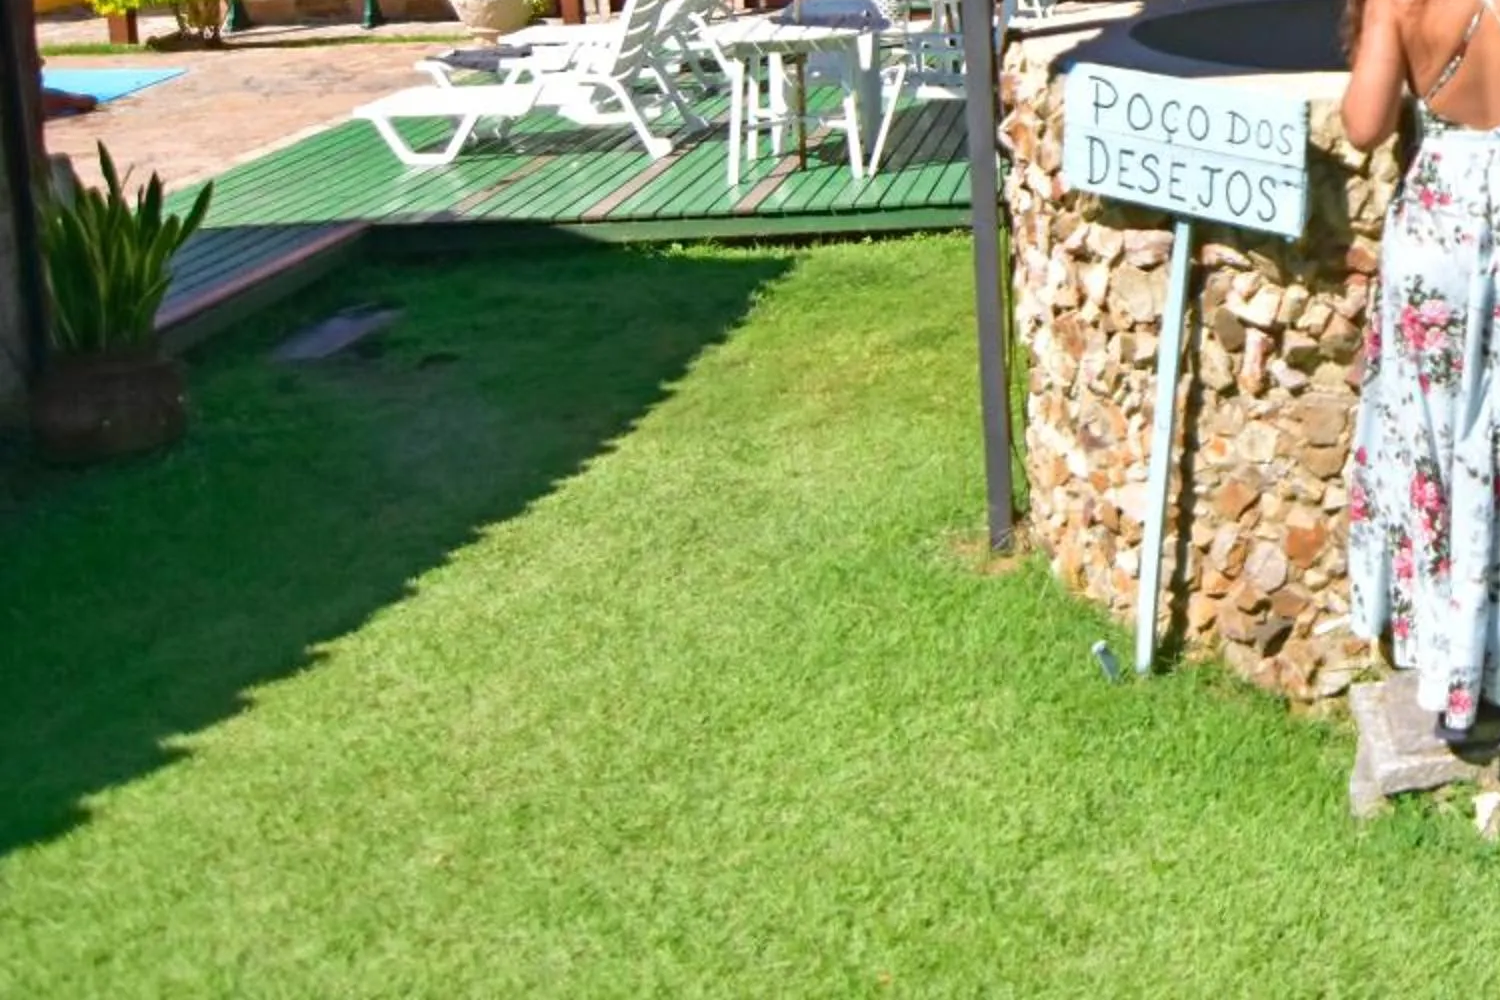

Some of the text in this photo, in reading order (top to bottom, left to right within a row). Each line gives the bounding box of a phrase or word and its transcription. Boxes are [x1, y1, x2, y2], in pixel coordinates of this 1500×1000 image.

[1088, 75, 1296, 156] POÇO DOS
[1084, 135, 1277, 223] DESEJOS
